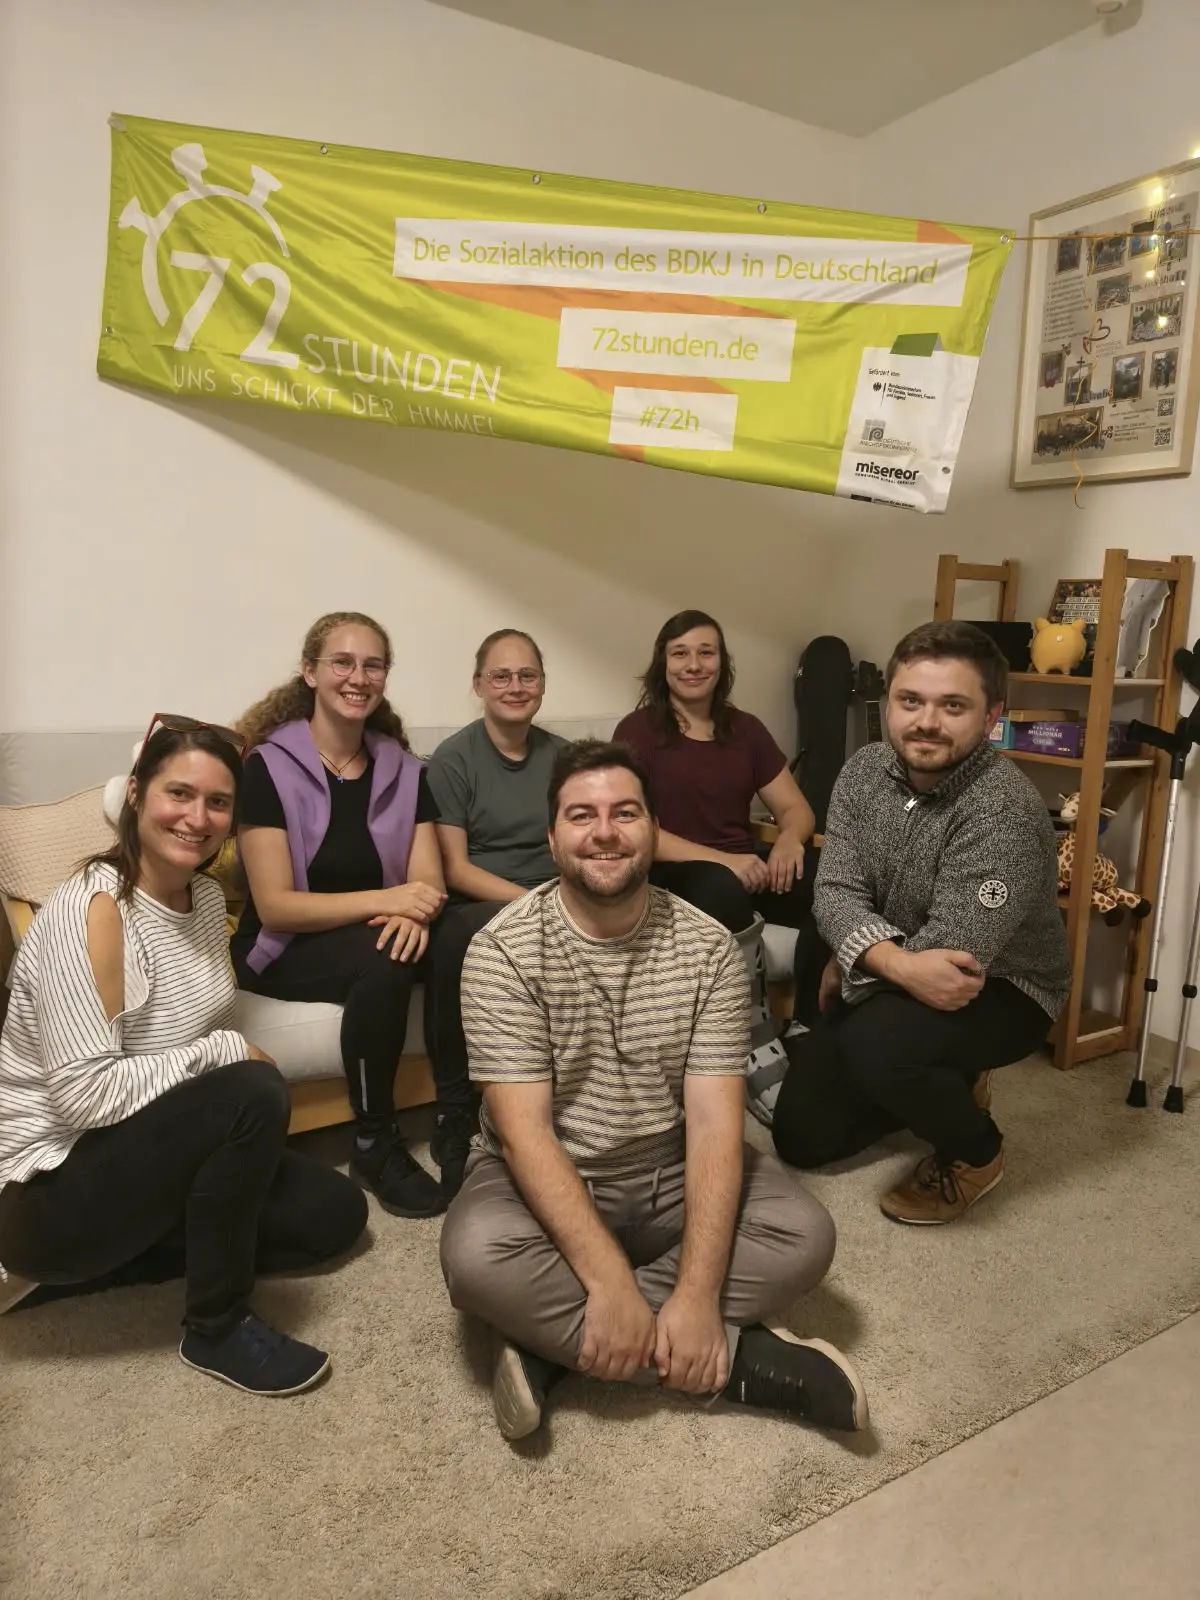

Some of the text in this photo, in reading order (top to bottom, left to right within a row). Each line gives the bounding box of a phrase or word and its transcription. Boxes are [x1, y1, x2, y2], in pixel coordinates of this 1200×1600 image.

[413, 237, 938, 284] Die Sozialaktion des BDKJ in Deutschland
[169, 249, 300, 371] 72
[591, 326, 759, 361] 72stunden.de
[302, 333, 502, 403] STUNDEN
[173, 365, 502, 436] UNS SCHICKT DER HIMMEL
[639, 405, 700, 432] #72h
[855, 461, 920, 480] misereor
